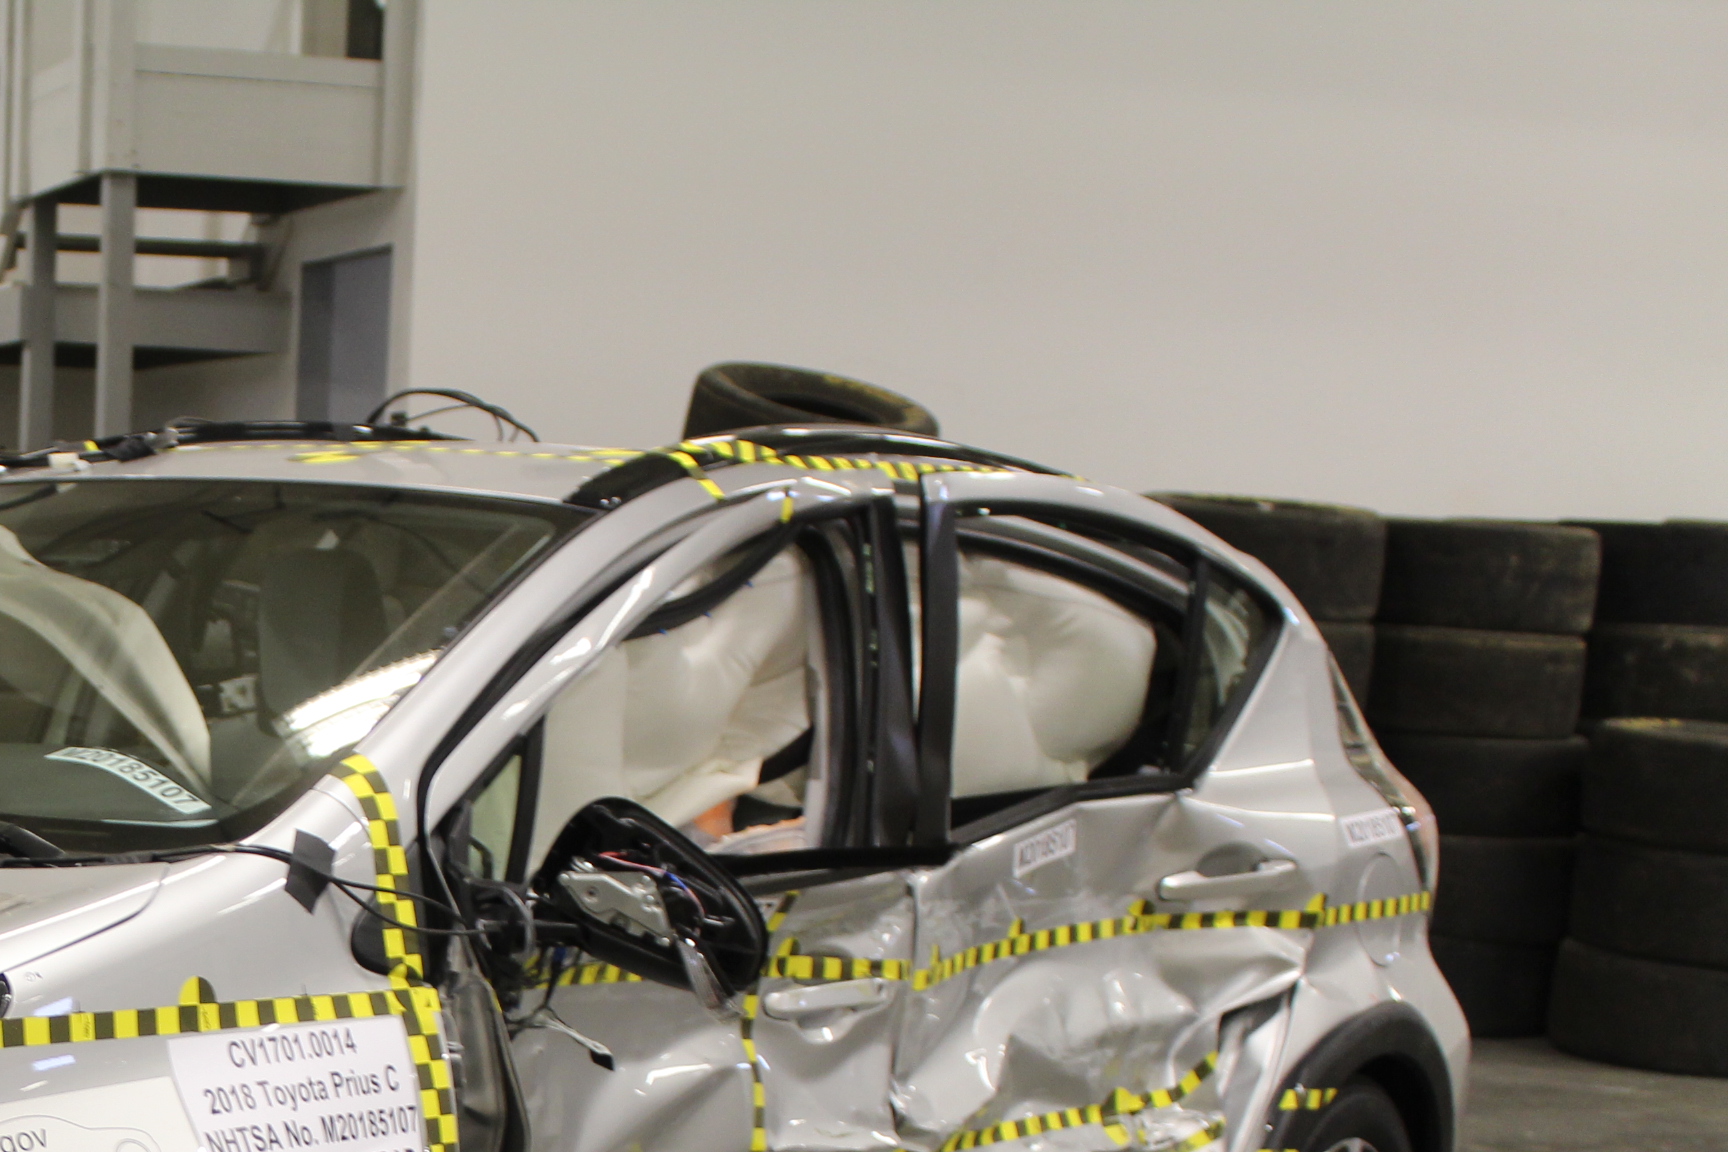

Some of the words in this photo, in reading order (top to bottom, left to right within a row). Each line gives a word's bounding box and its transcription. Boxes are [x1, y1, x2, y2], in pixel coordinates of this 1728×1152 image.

[227, 1027, 357, 1068] CV1701.0014
[203, 1083, 255, 1115] 2018
[257, 1077, 328, 1111] Toyota
[330, 1069, 381, 1098] Prius
[385, 1064, 400, 1092] C
[282, 1119, 319, 1148] No.
[320, 1105, 418, 1144] M20185107
